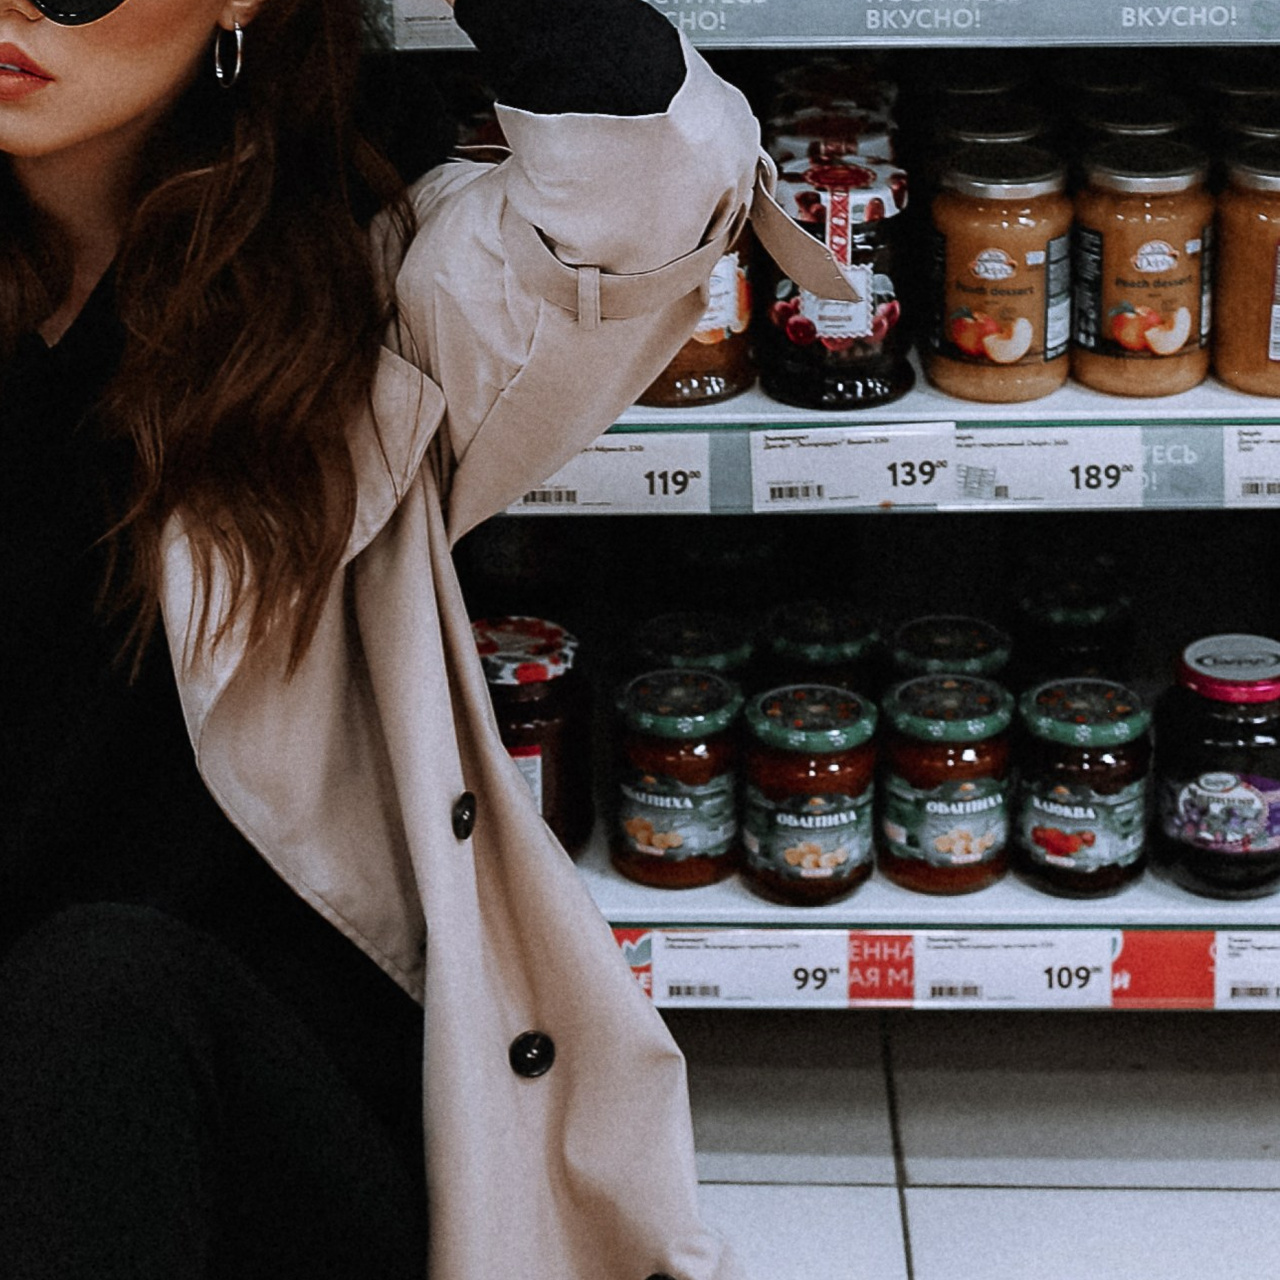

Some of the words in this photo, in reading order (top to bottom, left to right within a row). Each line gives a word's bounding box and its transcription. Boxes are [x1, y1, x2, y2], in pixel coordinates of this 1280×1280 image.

[866, 7, 980, 29] ВКУСНО!
[1122, 5, 1237, 27] ВКУСНО!
[644, 470, 686, 496] 119
[887, 460, 935, 487] 139
[1070, 464, 1121, 490] 189
[793, 967, 826, 990] 99
[1044, 966, 1090, 989] 109
